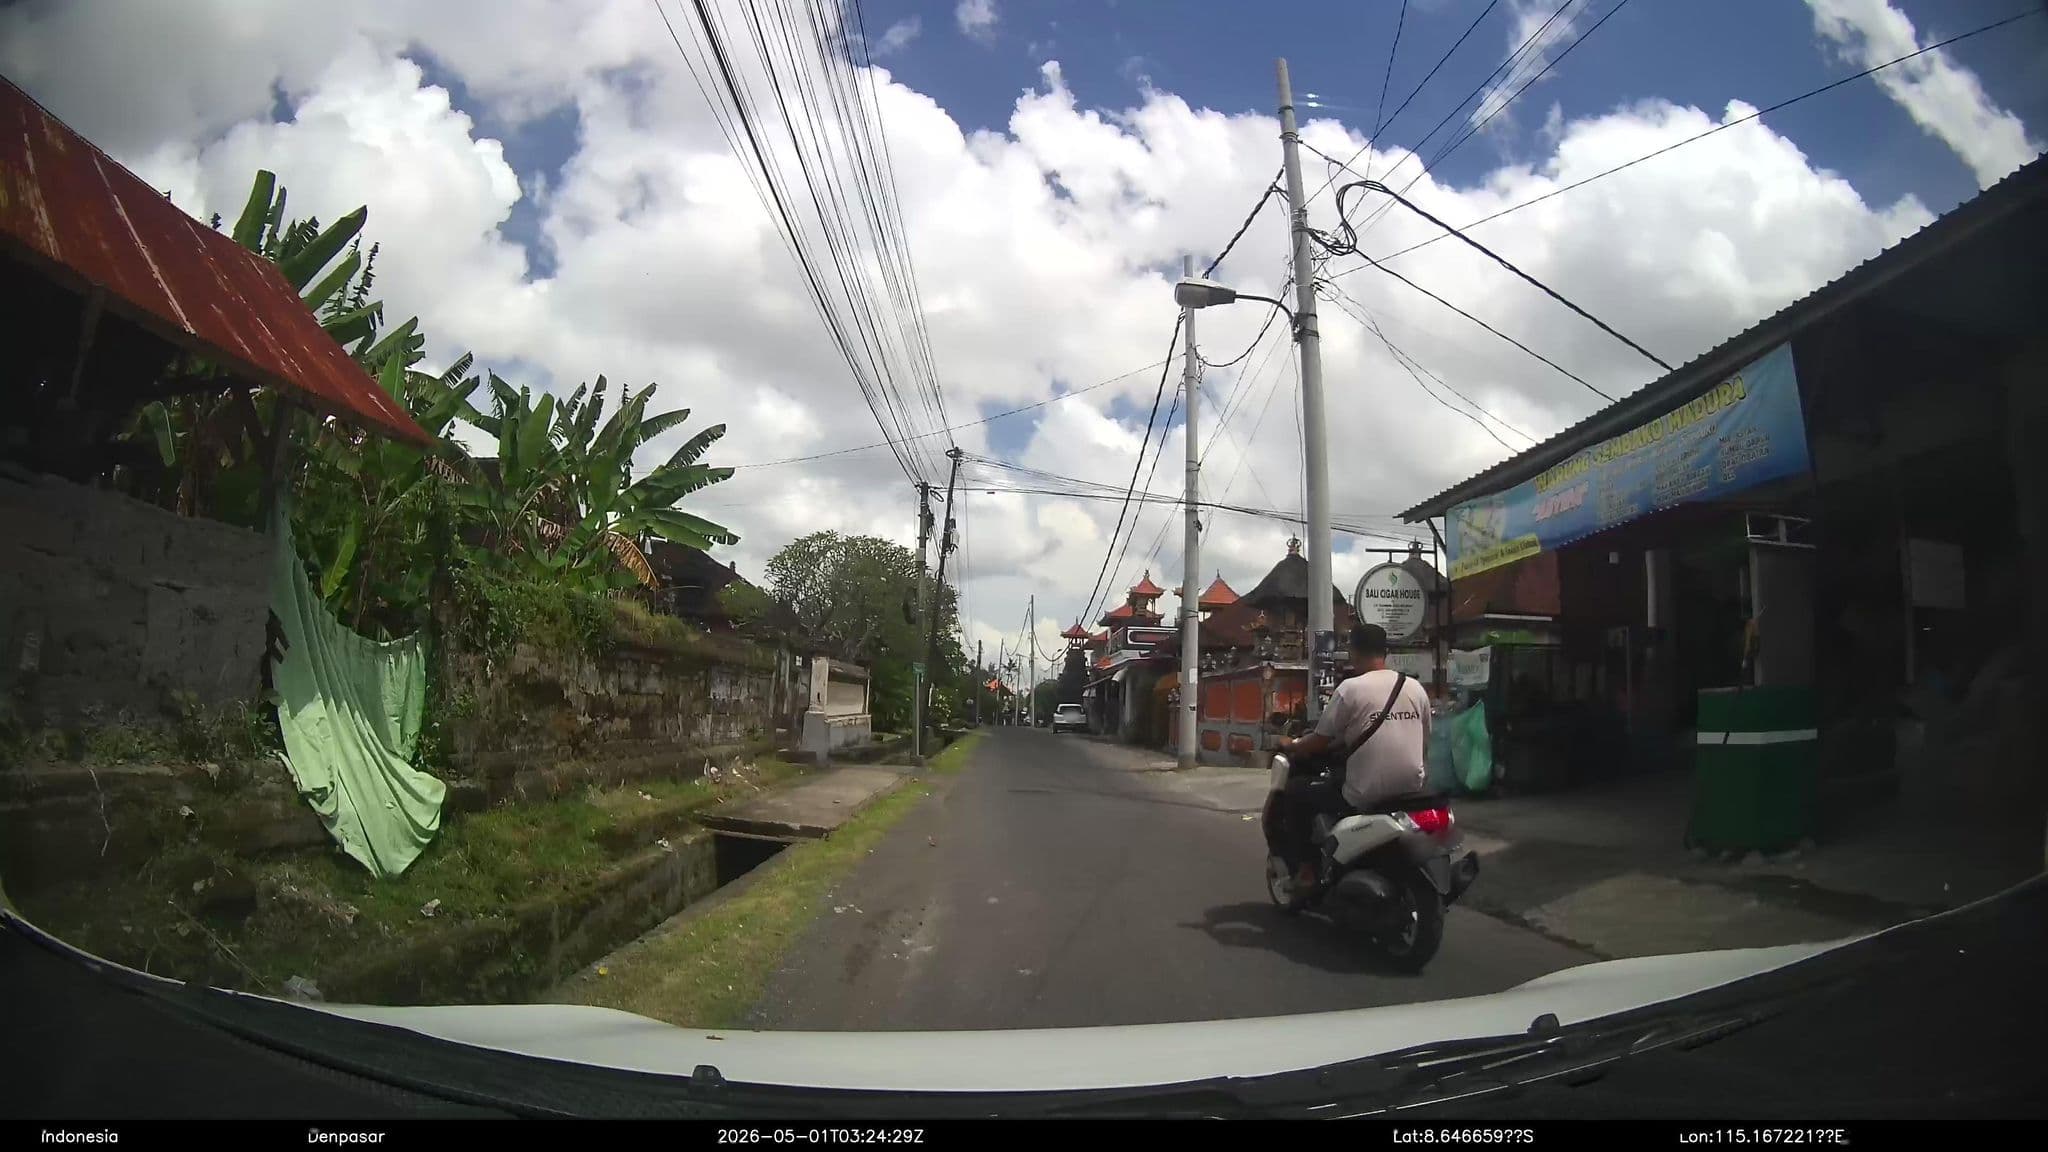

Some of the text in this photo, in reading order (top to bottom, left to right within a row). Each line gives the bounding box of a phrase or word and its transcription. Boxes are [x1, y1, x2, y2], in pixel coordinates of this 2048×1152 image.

[1534, 454, 1590, 493] WARUNG
[1592, 419, 1665, 465] SEMBAKO
[1667, 376, 1746, 434] MADURA
[1365, 588, 1421, 600] BALI CIGAR HOUSE
